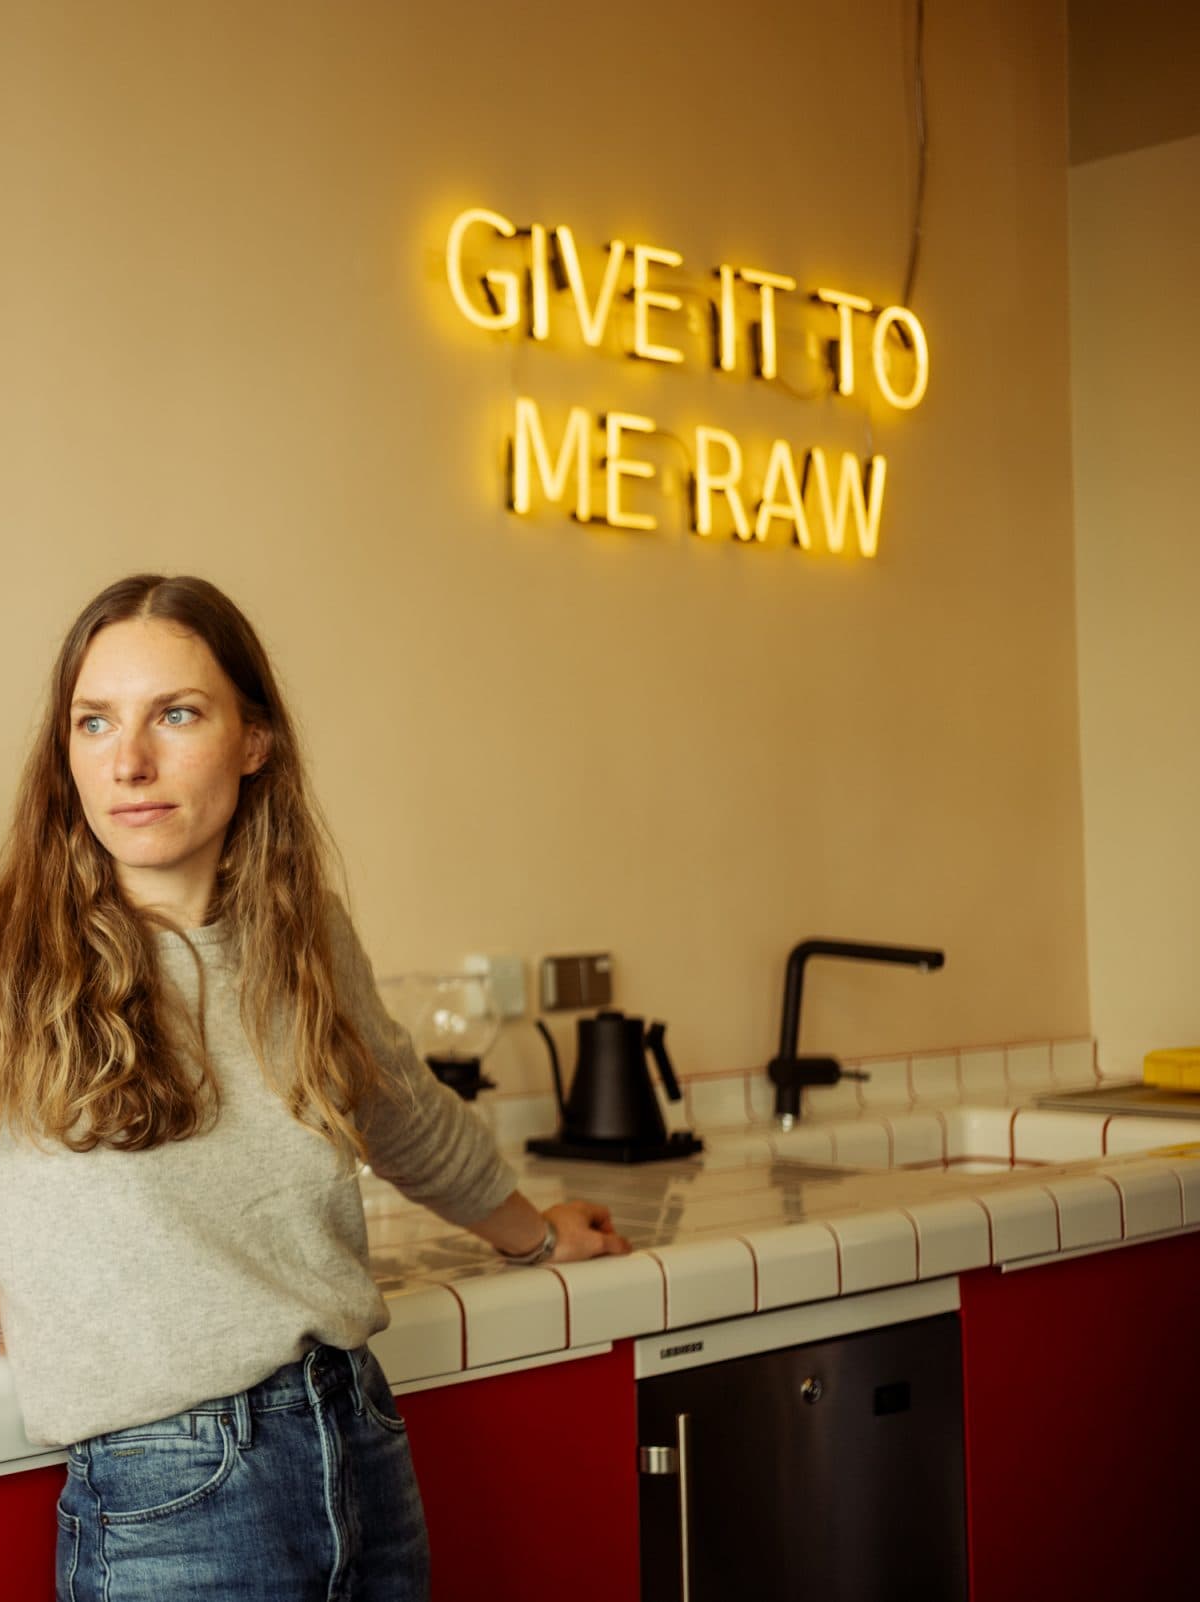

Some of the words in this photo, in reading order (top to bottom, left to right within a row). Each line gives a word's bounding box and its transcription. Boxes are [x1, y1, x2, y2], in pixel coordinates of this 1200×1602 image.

[446, 207, 683, 363] GIVE
[717, 263, 796, 380] IT
[815, 287, 929, 410] TO
[513, 397, 657, 531] ME
[696, 425, 887, 559] RAW
